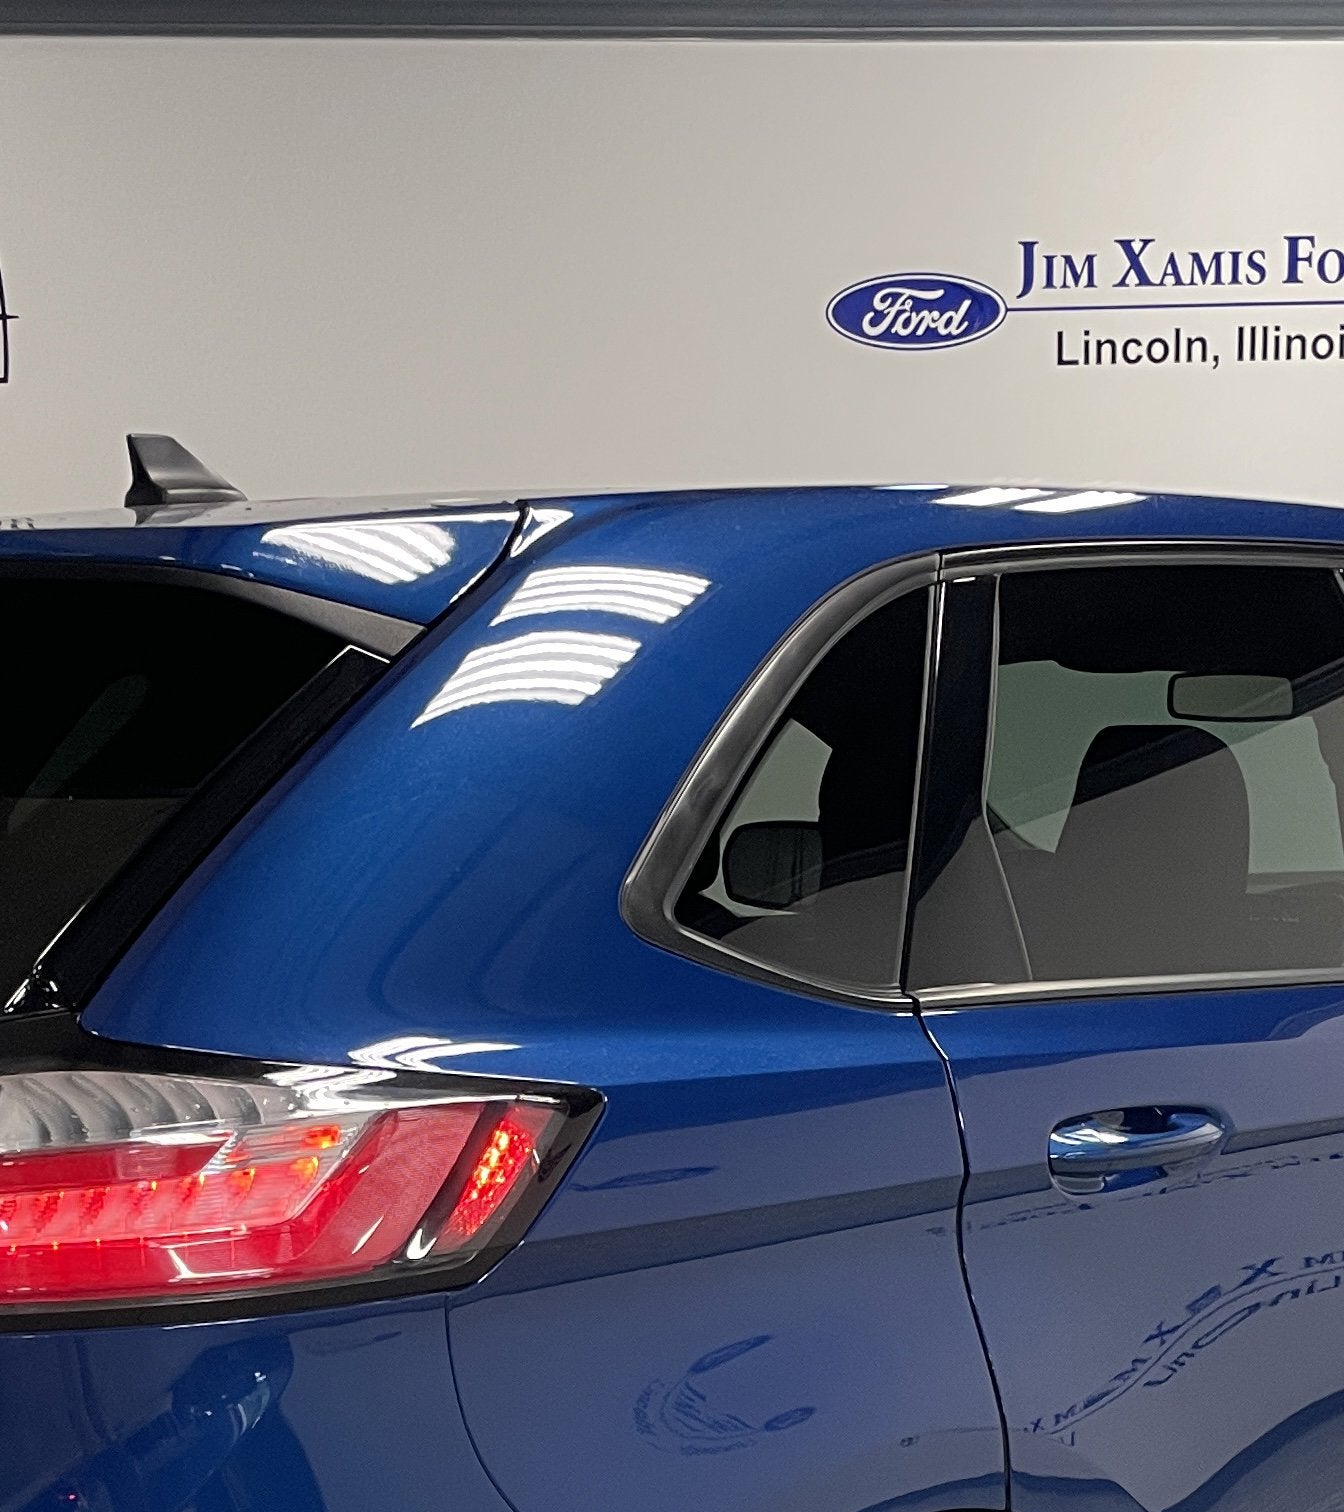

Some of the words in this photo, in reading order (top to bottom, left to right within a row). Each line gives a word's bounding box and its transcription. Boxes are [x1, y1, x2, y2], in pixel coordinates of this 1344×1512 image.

[1015, 240, 1098, 300] JIM
[1112, 238, 1266, 288] XAMIS
[861, 286, 973, 337] Ford
[1056, 328, 1219, 370] Lincoln,
